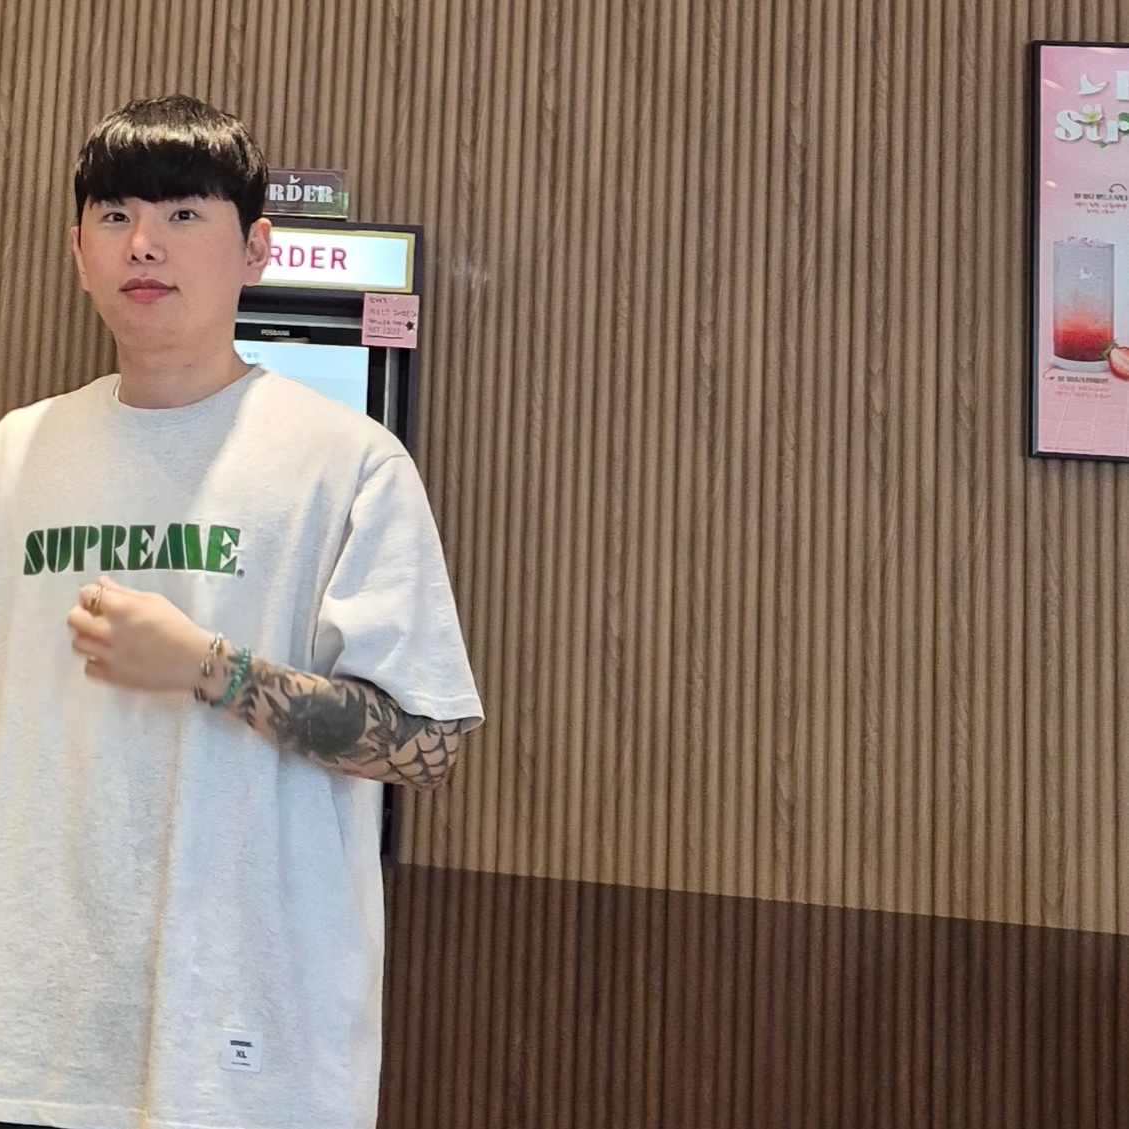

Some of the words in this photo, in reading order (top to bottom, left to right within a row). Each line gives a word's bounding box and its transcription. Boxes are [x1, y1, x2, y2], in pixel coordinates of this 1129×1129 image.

[266, 183, 333, 203] RDER
[269, 244, 347, 270] RDER
[23, 523, 241, 575] SUPREME
